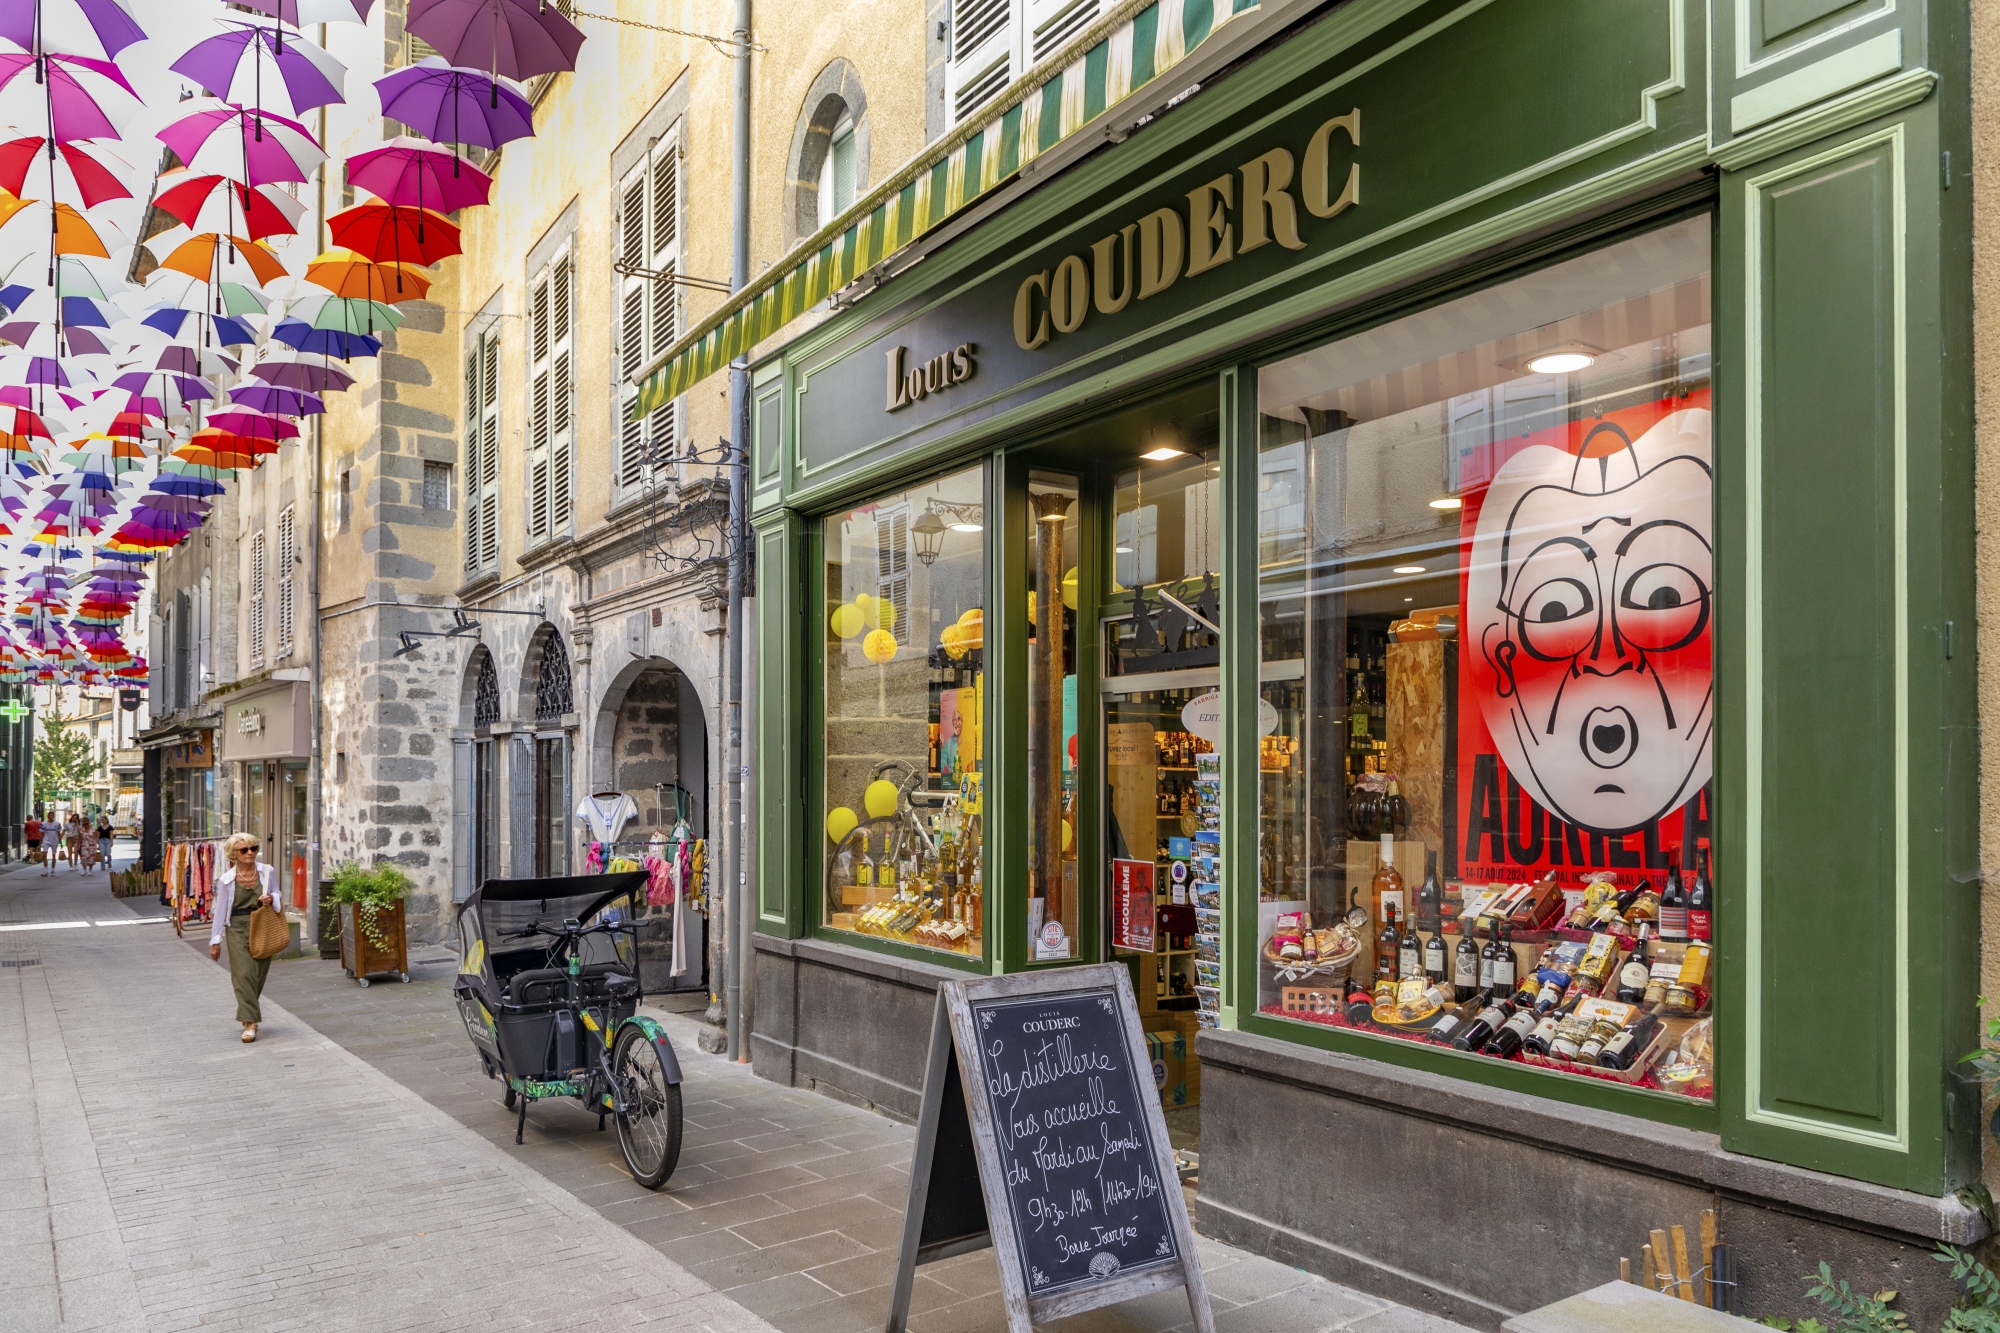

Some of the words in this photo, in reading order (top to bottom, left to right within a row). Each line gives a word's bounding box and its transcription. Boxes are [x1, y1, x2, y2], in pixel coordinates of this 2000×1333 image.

[1013, 107, 1361, 351] COUDERC
[1465, 866, 1483, 879] 14-17
[1507, 868, 1527, 881] 2024
[1534, 869, 1569, 883] FESVAL
[1047, 925, 1058, 933] SITE
[1022, 1016, 1081, 1033] COUDERC
[988, 1039, 1019, 1098] La
[1020, 1033, 1117, 1089] distillerie
[1045, 1076, 1121, 1129] accueille
[1008, 1159, 1032, 1187] du
[1076, 1145, 1100, 1164] au
